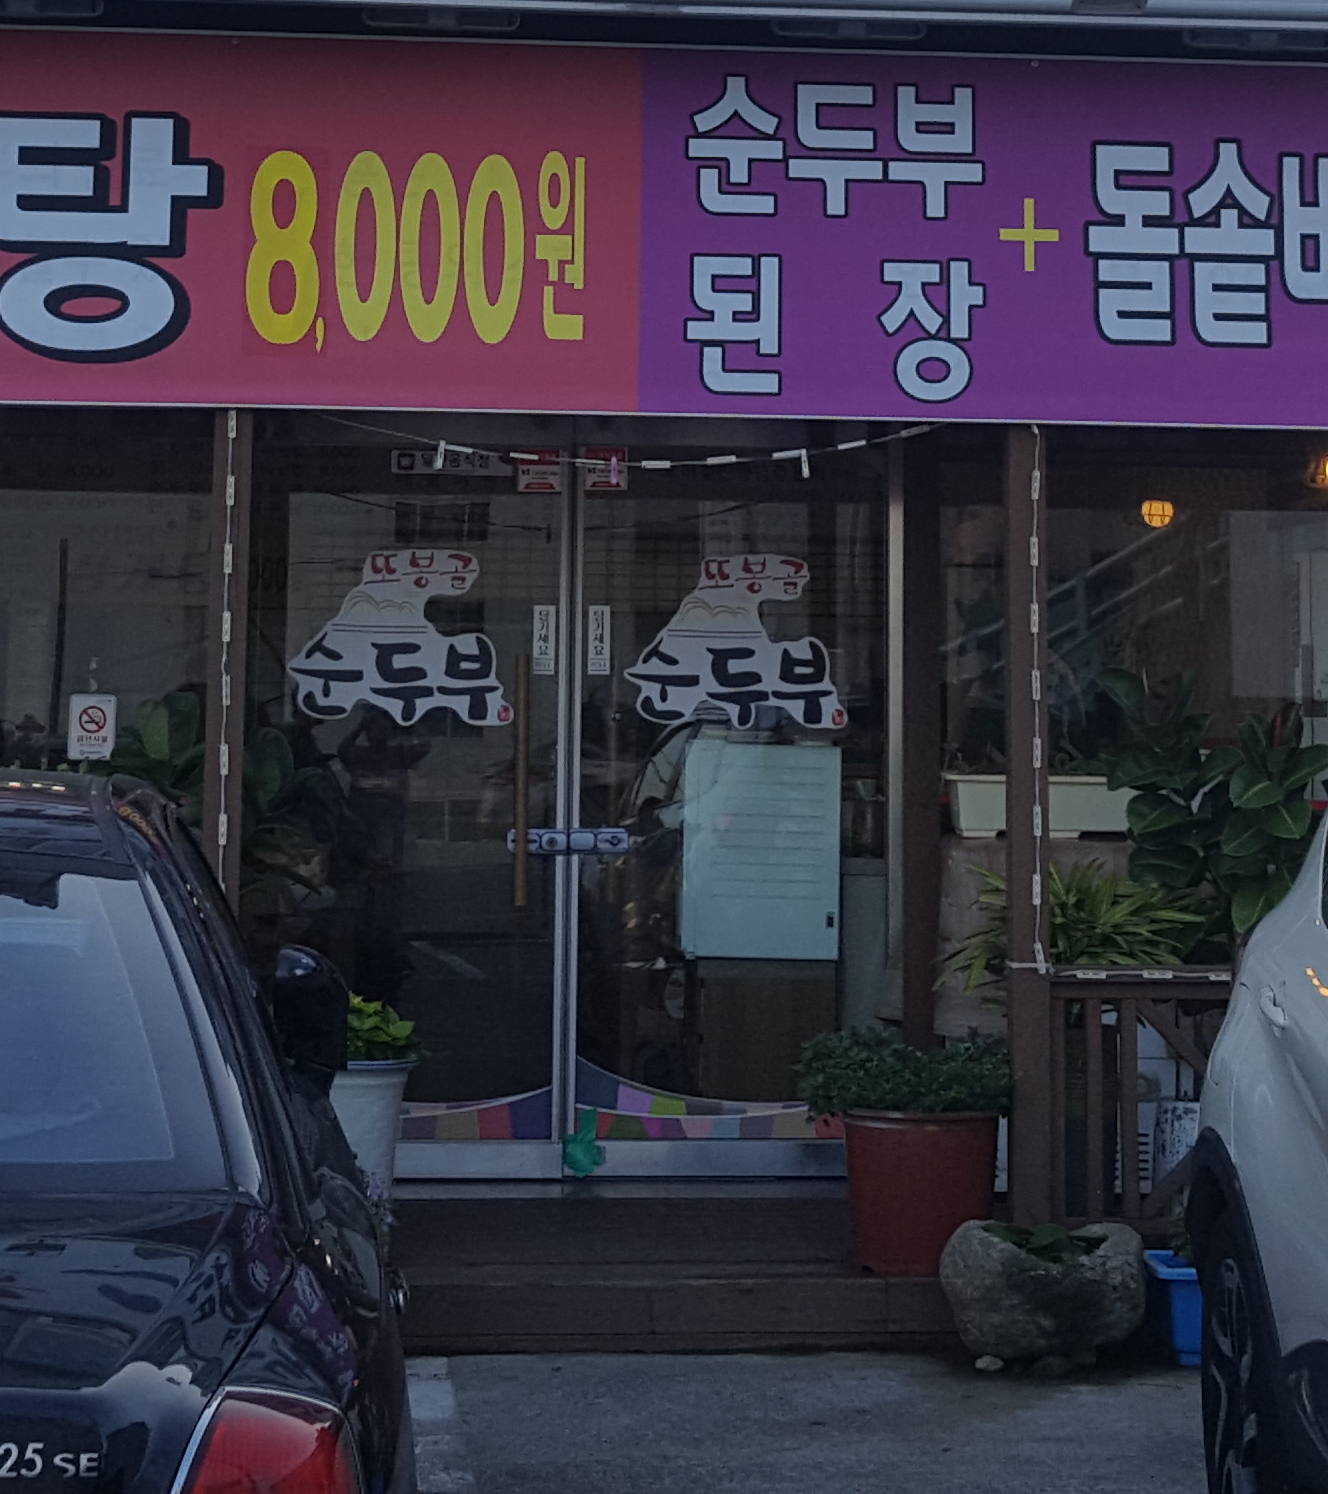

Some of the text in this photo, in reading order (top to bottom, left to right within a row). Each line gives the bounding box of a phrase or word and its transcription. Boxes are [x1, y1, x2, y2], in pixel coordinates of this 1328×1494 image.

[686, 74, 985, 220] 순두부
[245, 149, 586, 354] 8,000원
[364, 552, 476, 589] 또봉골
[698, 557, 808, 594] 또봉골
[288, 632, 501, 723] 순두부
[625, 636, 835, 727] 순두부
[53, 1452, 99, 1478] SE
